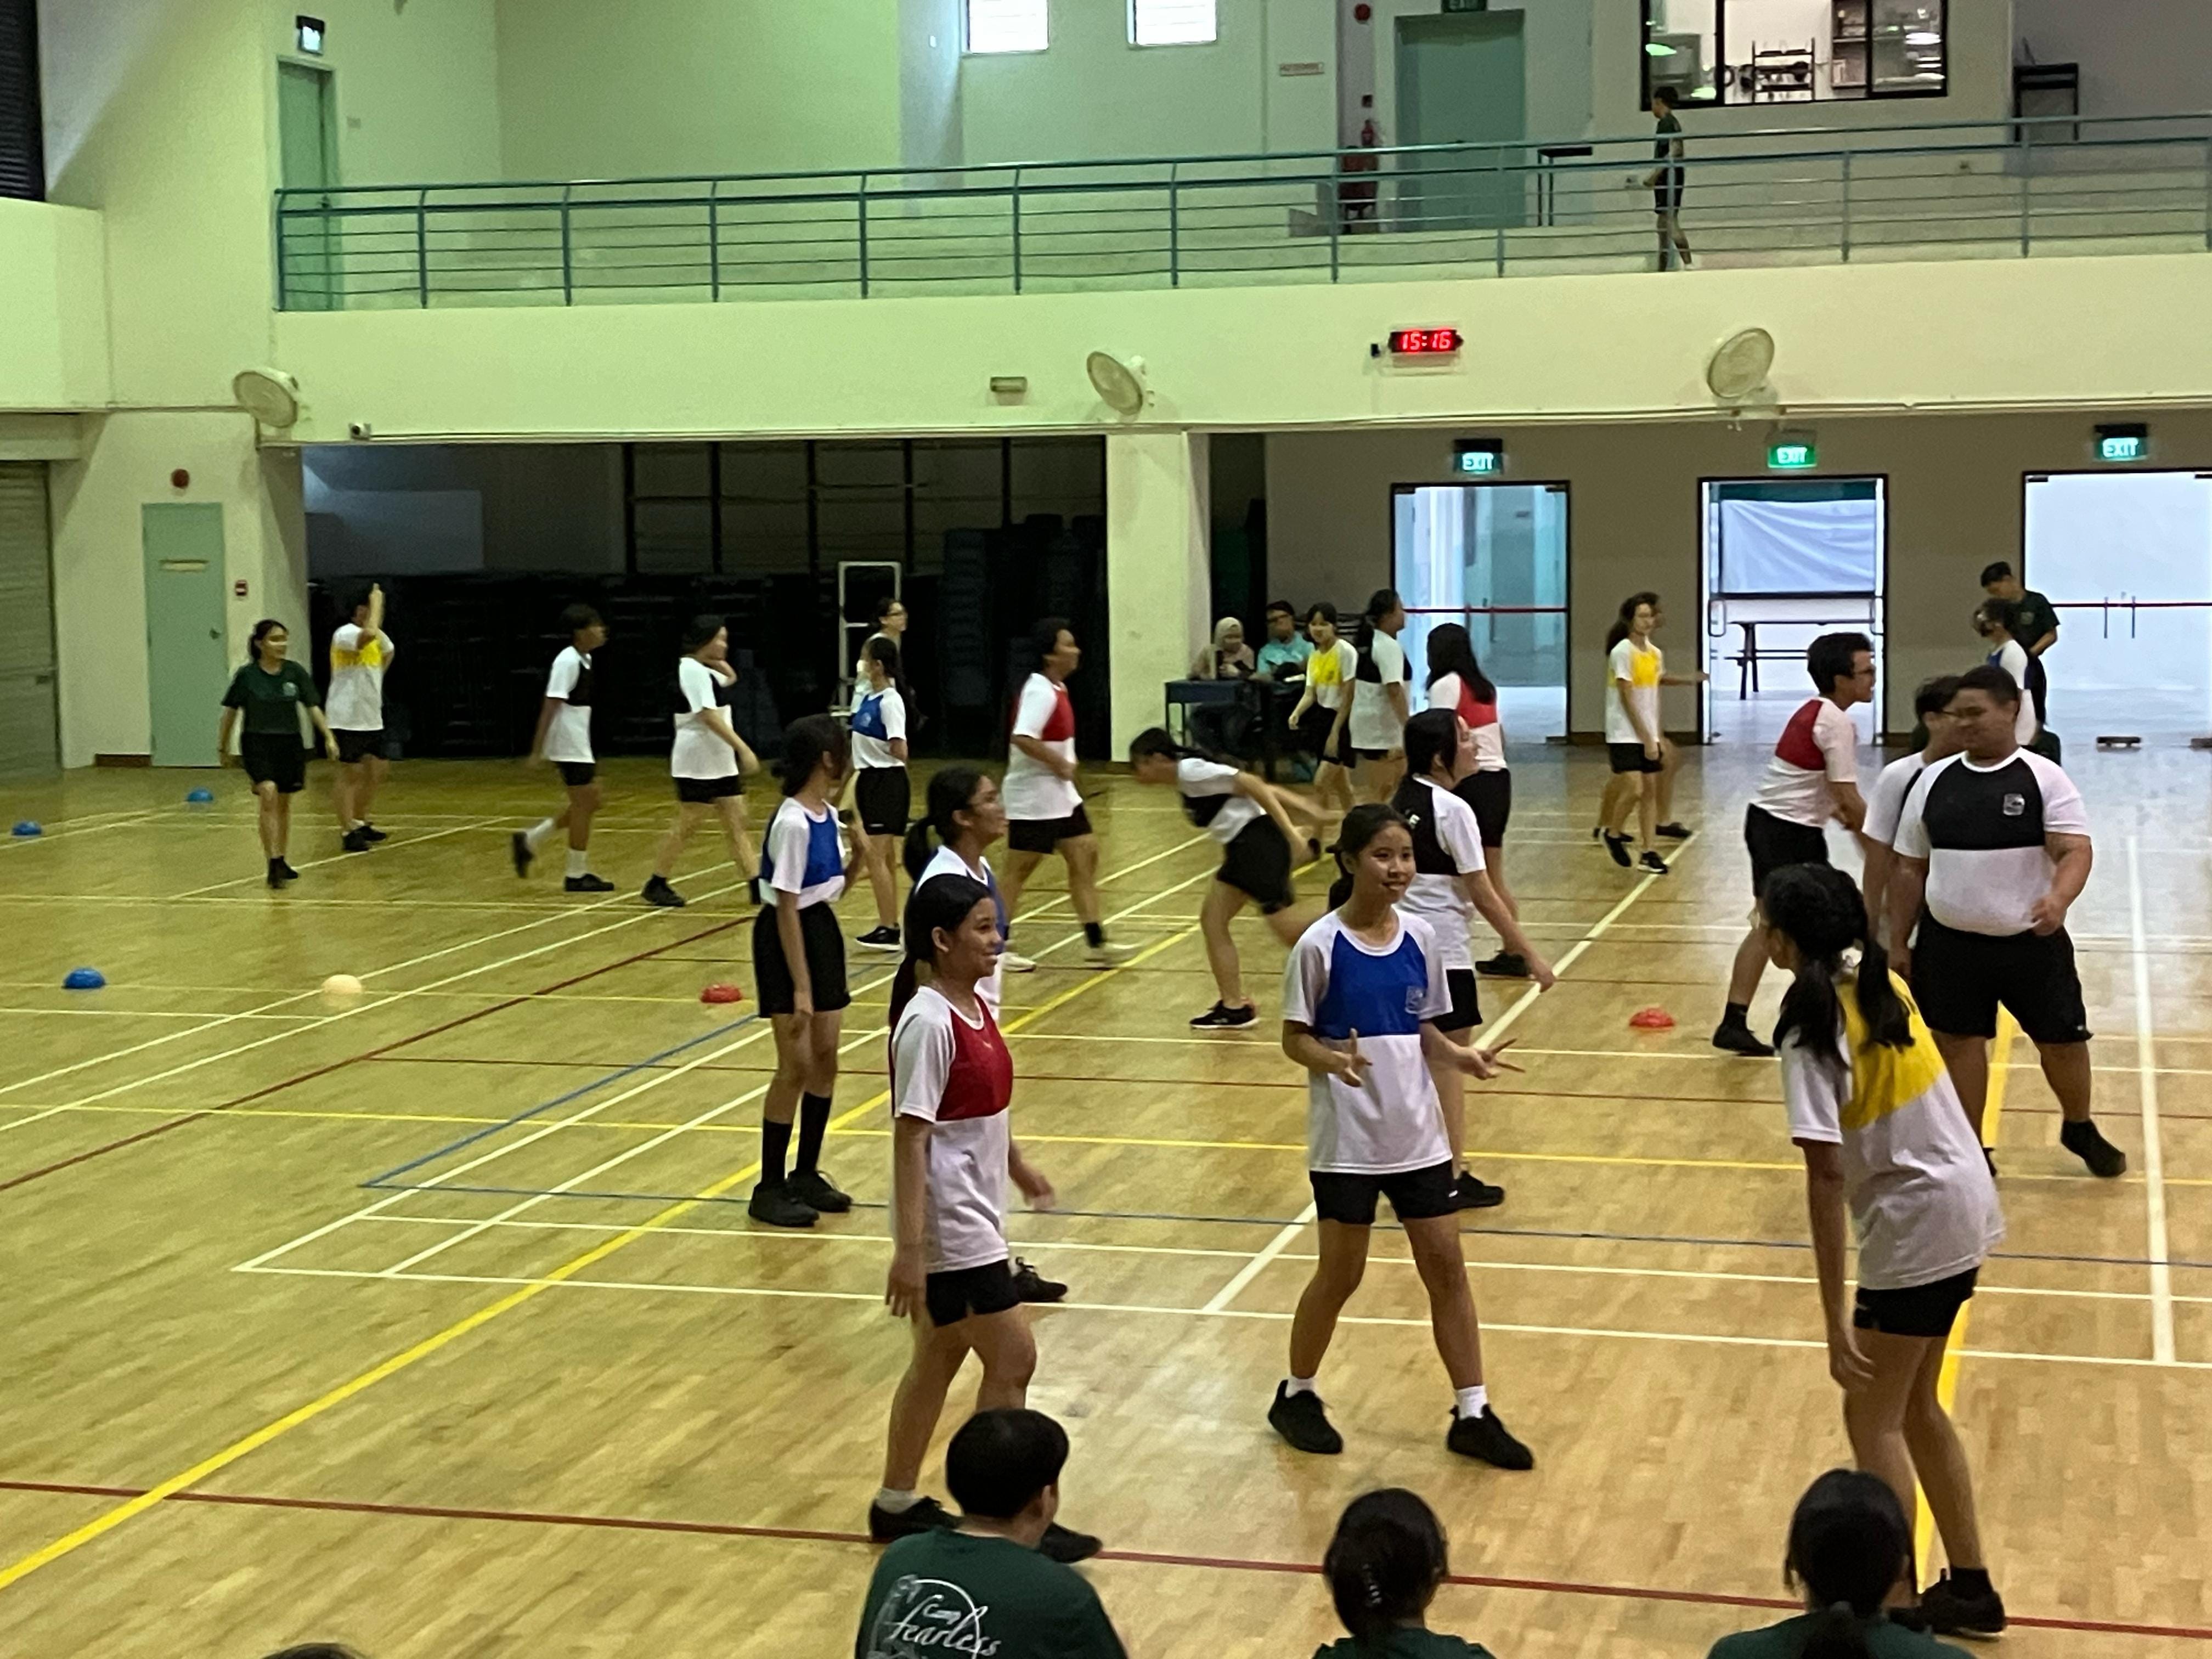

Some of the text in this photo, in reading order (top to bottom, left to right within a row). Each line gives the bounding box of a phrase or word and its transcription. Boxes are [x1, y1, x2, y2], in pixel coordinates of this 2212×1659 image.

[1401, 331, 1452, 350] 15:16
[1776, 447, 1808, 464] EXIT
[2102, 437, 2138, 458] EXIT
[1462, 452, 1494, 470] EXIT
